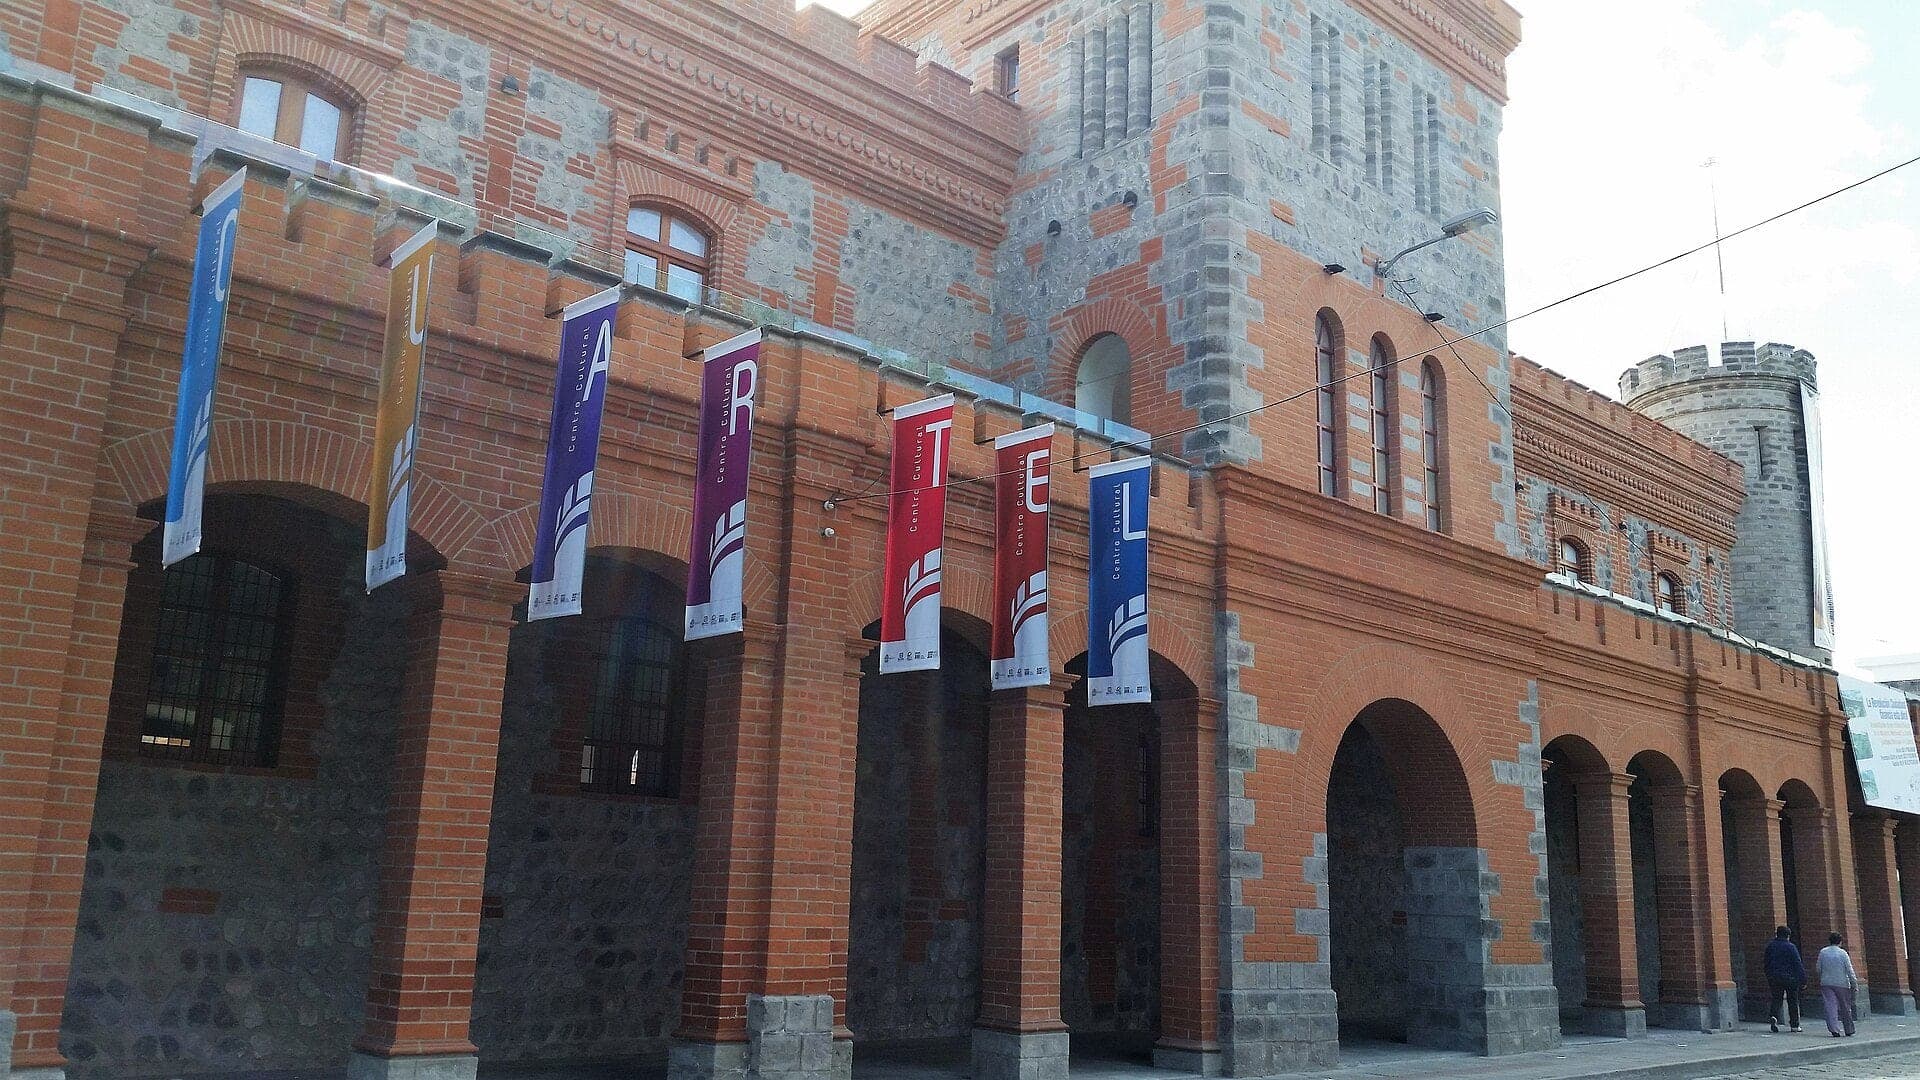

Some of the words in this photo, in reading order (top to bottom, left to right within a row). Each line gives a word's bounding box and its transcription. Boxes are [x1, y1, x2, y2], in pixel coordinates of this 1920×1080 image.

[410, 254, 434, 346] U
[568, 401, 581, 452] Centro
[575, 326, 591, 391] Cultural
[582, 319, 612, 402] A
[721, 365, 732, 426] Cultural
[729, 359, 758, 436] R
[717, 436, 727, 483] Centro
[912, 425, 924, 481] Cultural
[925, 418, 953, 488] T
[1016, 454, 1025, 507] Cultural
[1026, 448, 1050, 514] E
[909, 489, 920, 532] Centro
[1016, 514, 1025, 556] Centro
[1113, 483, 1121, 533] Cultural
[1122, 481, 1147, 541] L
[1113, 541, 1121, 580] Centro
